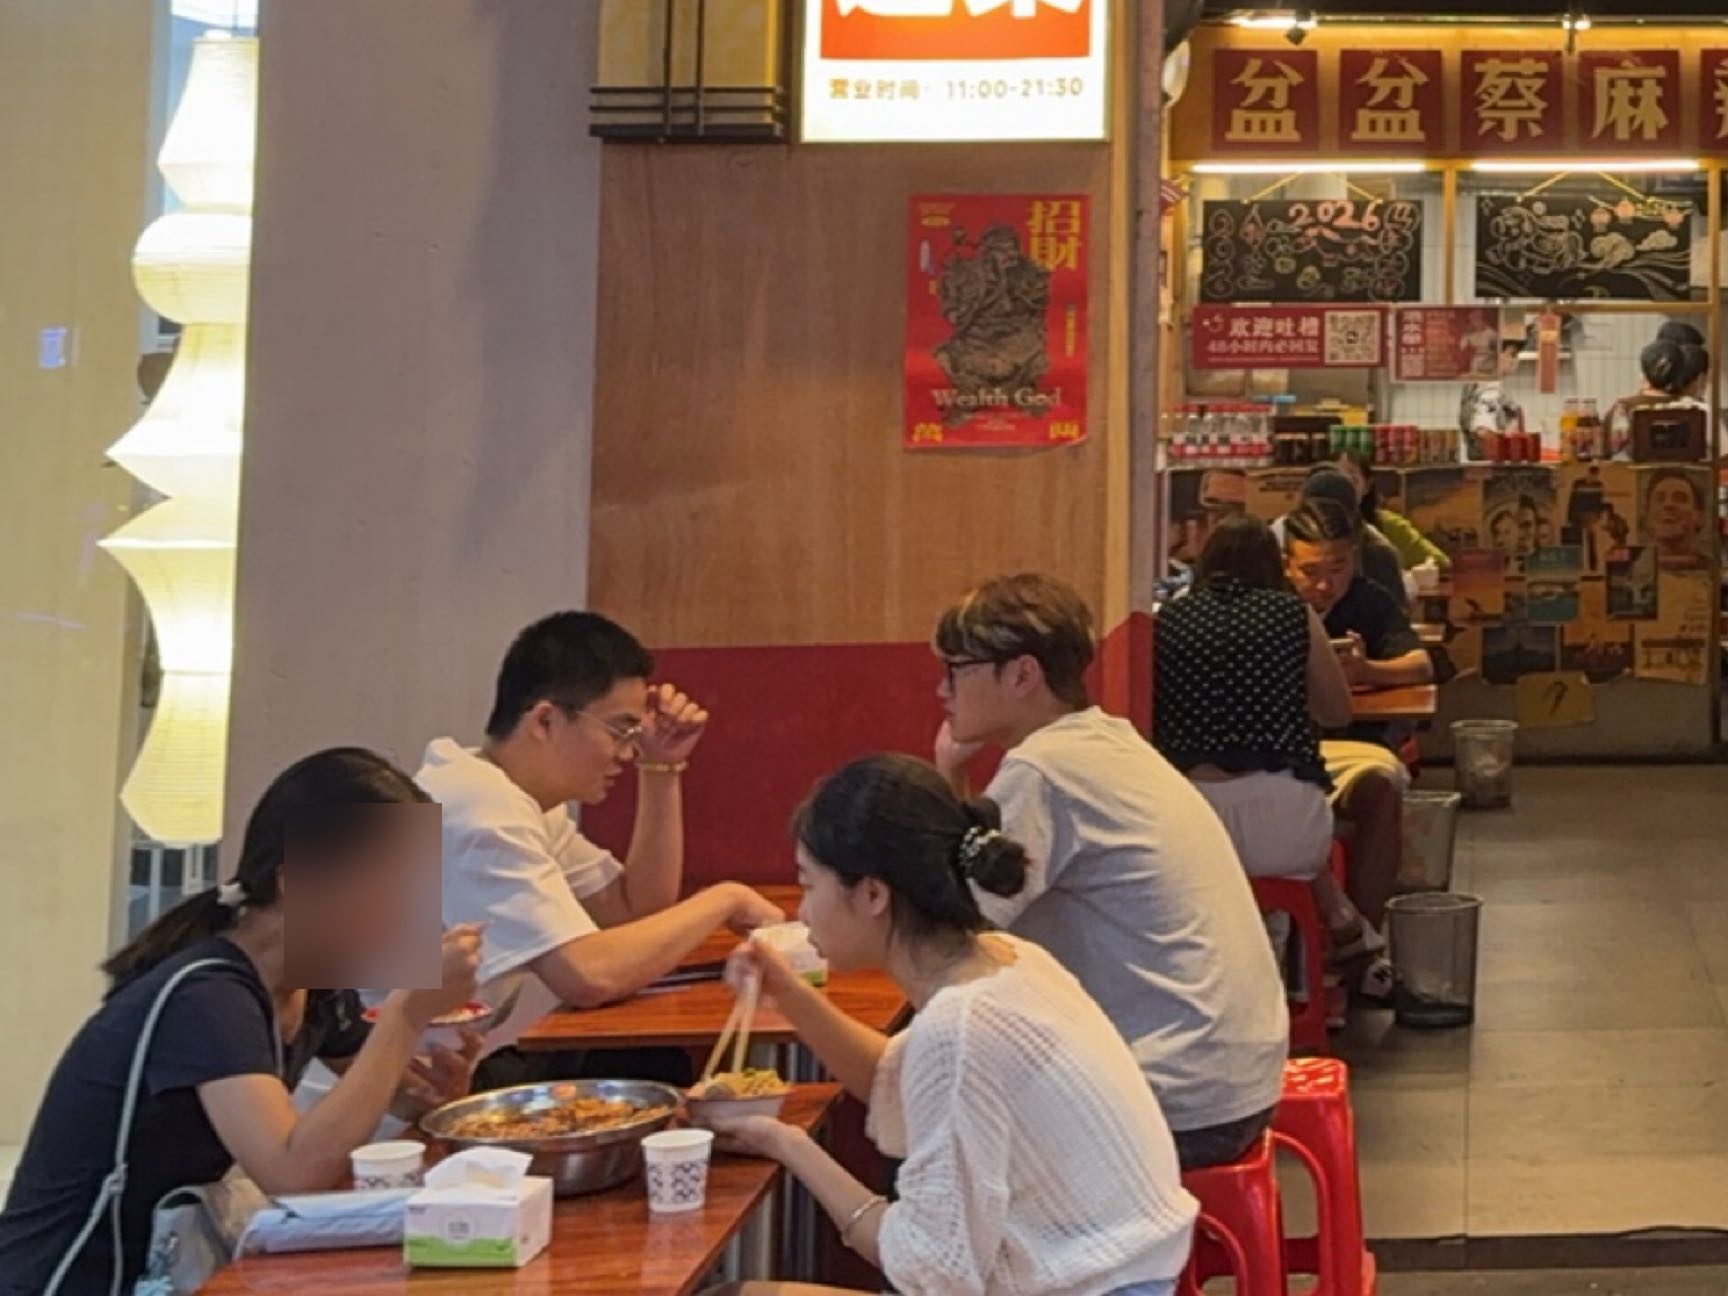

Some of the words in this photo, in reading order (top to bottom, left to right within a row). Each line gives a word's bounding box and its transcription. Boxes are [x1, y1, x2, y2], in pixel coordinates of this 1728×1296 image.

[947, 77, 1084, 99] 11:00-21:30
[1288, 200, 1381, 231] 2026
[932, 387, 1009, 406] Wealth
[1014, 386, 1062, 406] God
